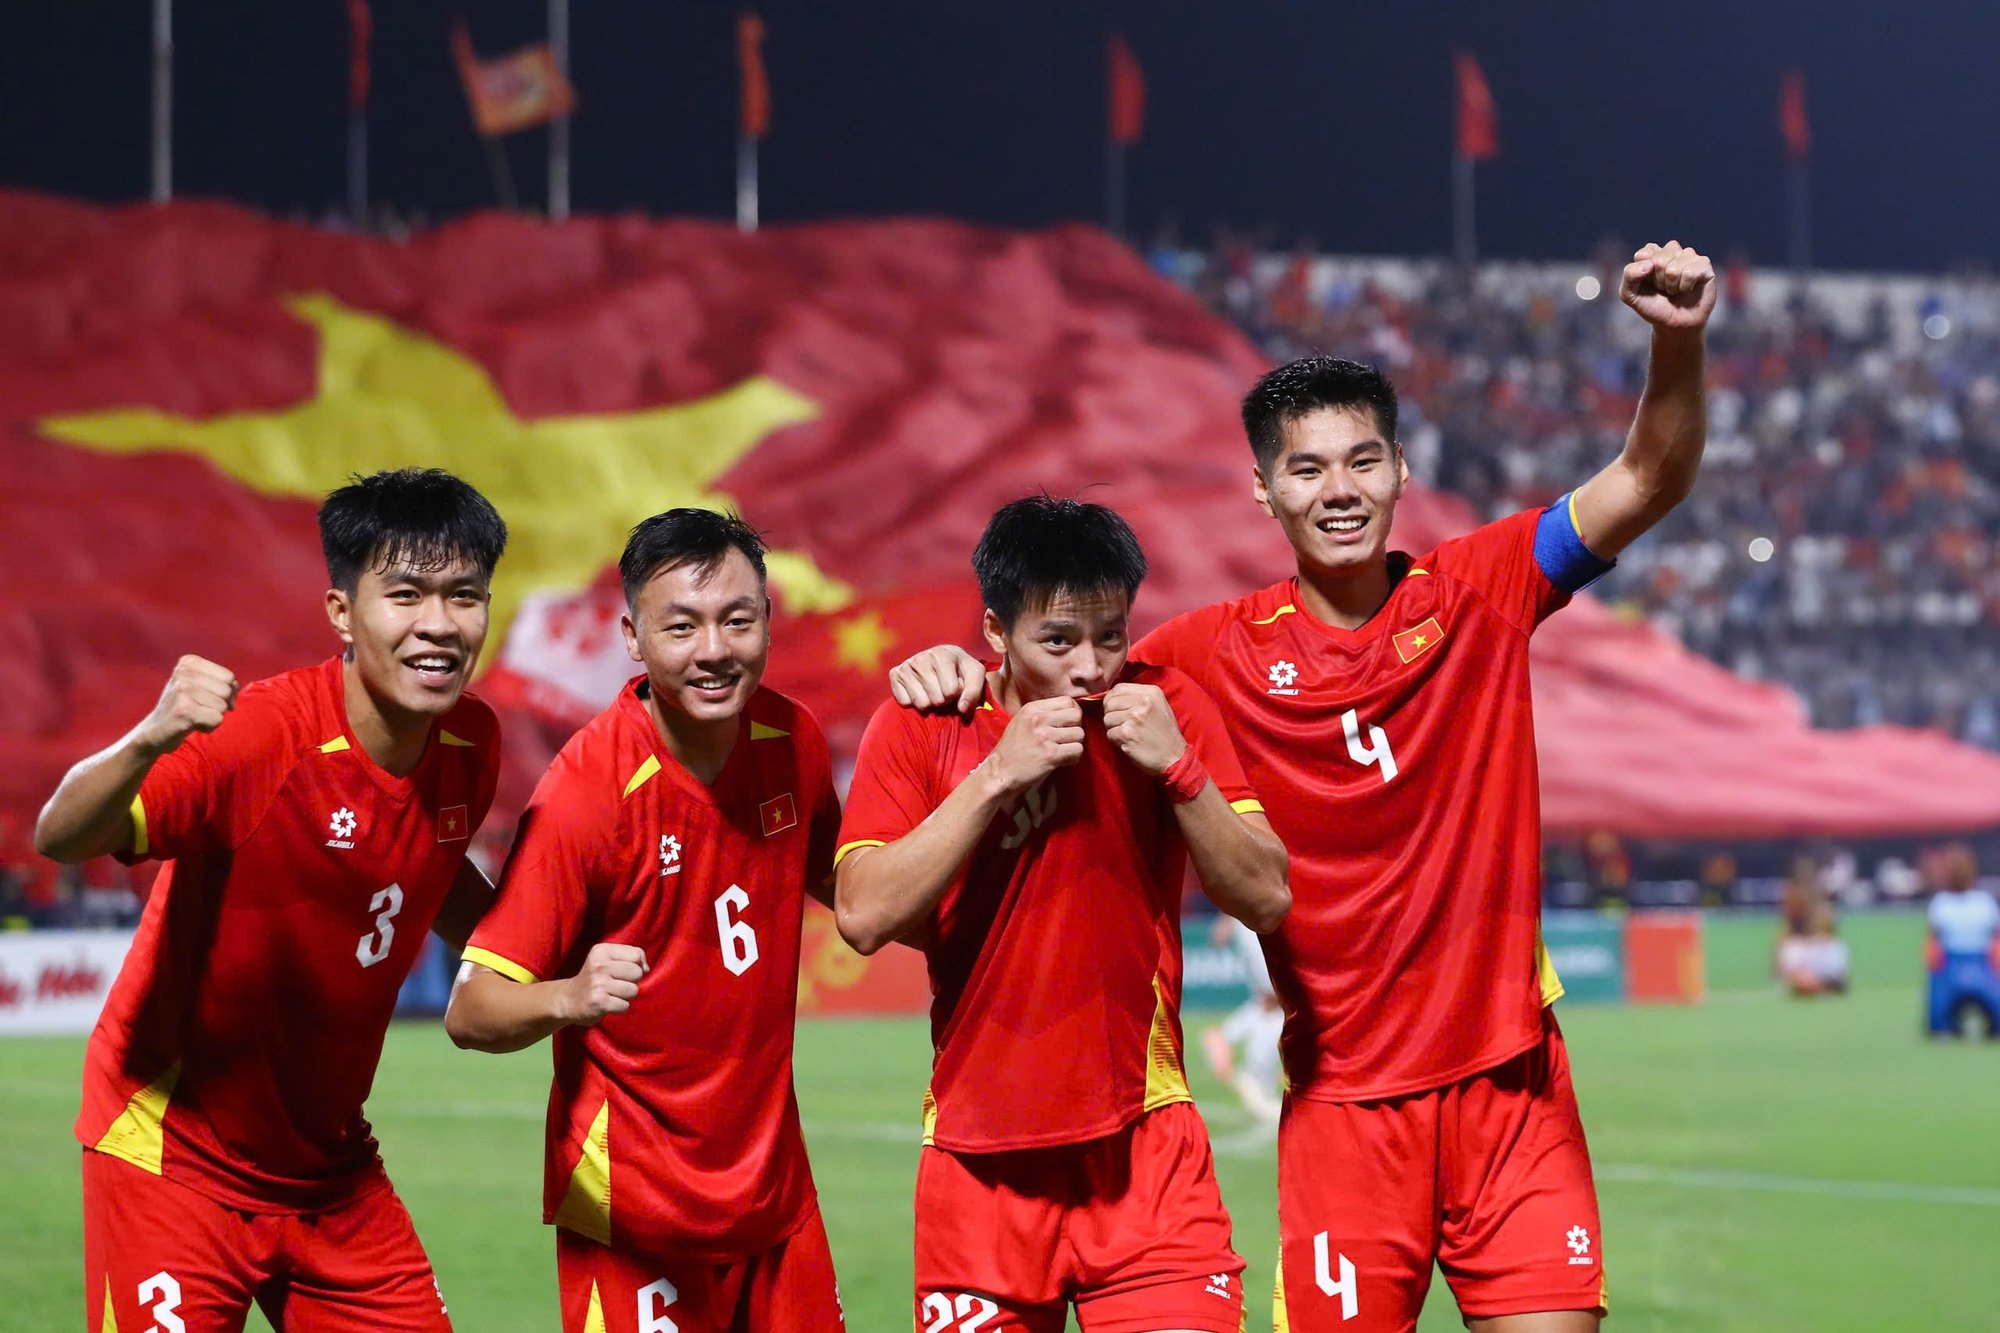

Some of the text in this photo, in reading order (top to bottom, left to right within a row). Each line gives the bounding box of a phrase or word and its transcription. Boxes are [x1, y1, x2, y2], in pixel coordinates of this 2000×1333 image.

[1340, 708, 1399, 784] 4
[355, 882, 404, 969] 3
[714, 883, 760, 977] 6
[137, 1270, 186, 1333] 3
[636, 1277, 679, 1333] 6
[1313, 1230, 1359, 1321] 4
